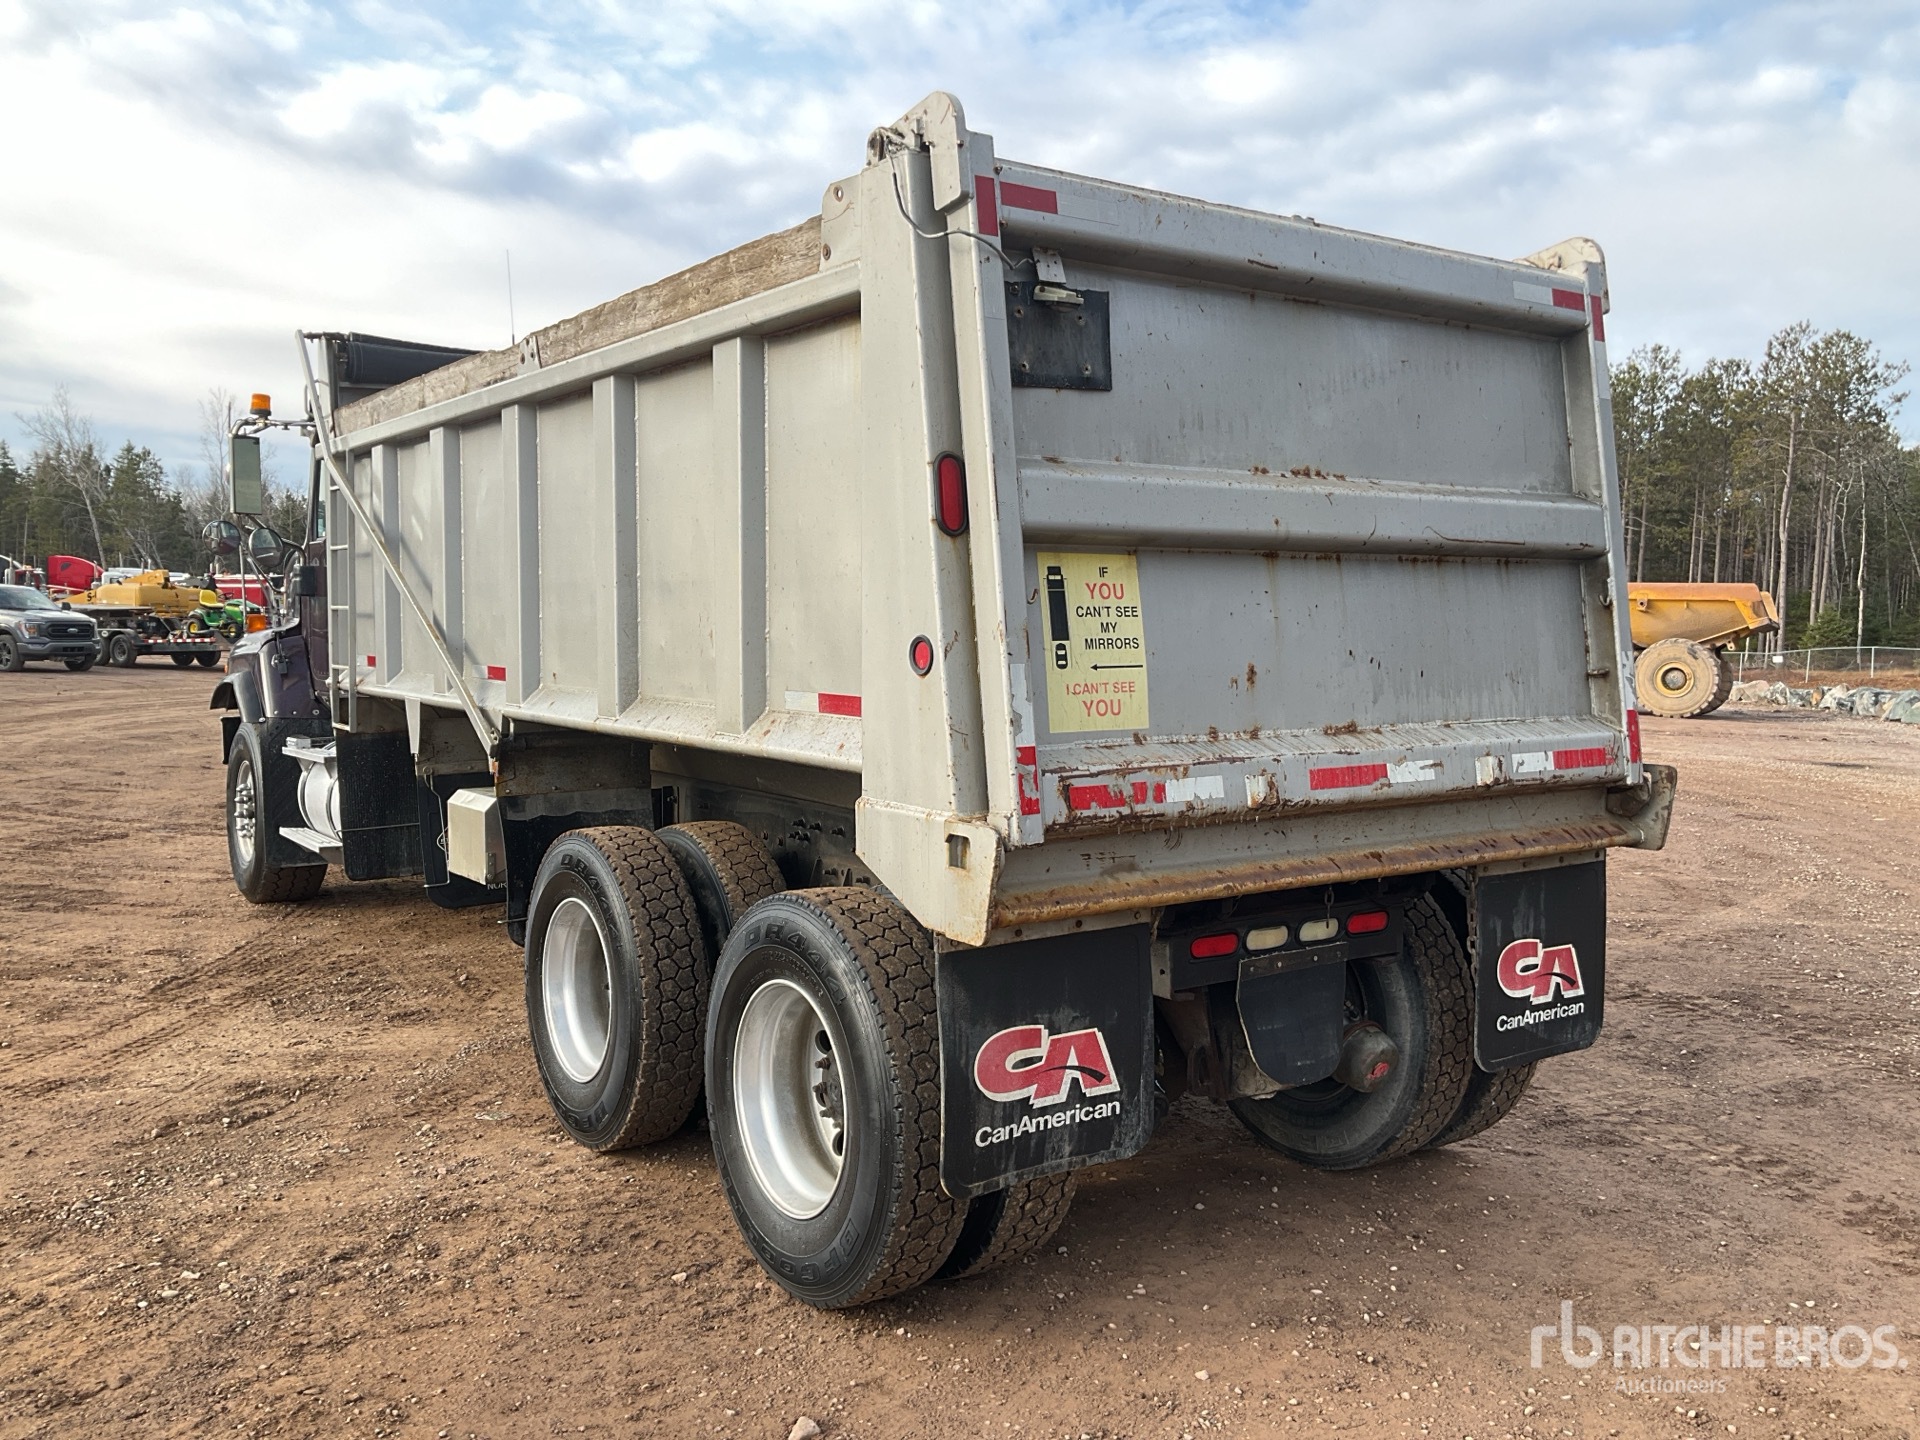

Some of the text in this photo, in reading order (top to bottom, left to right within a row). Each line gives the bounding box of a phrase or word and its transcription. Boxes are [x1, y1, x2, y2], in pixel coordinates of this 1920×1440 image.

[1098, 567, 1108, 578] IF
[1085, 583, 1125, 600] YOU
[1076, 605, 1139, 618] CAN'T SEE
[1100, 622, 1118, 634] MY
[1085, 637, 1140, 650] MIRRORS
[1066, 681, 1136, 696] I CAN'T SEE
[1082, 699, 1121, 717] YOU
[1496, 938, 1585, 1006] CA
[1496, 1002, 1585, 1032] CanAmerican
[974, 1024, 1121, 1109] CA
[974, 1100, 1121, 1148] CanAmerican
